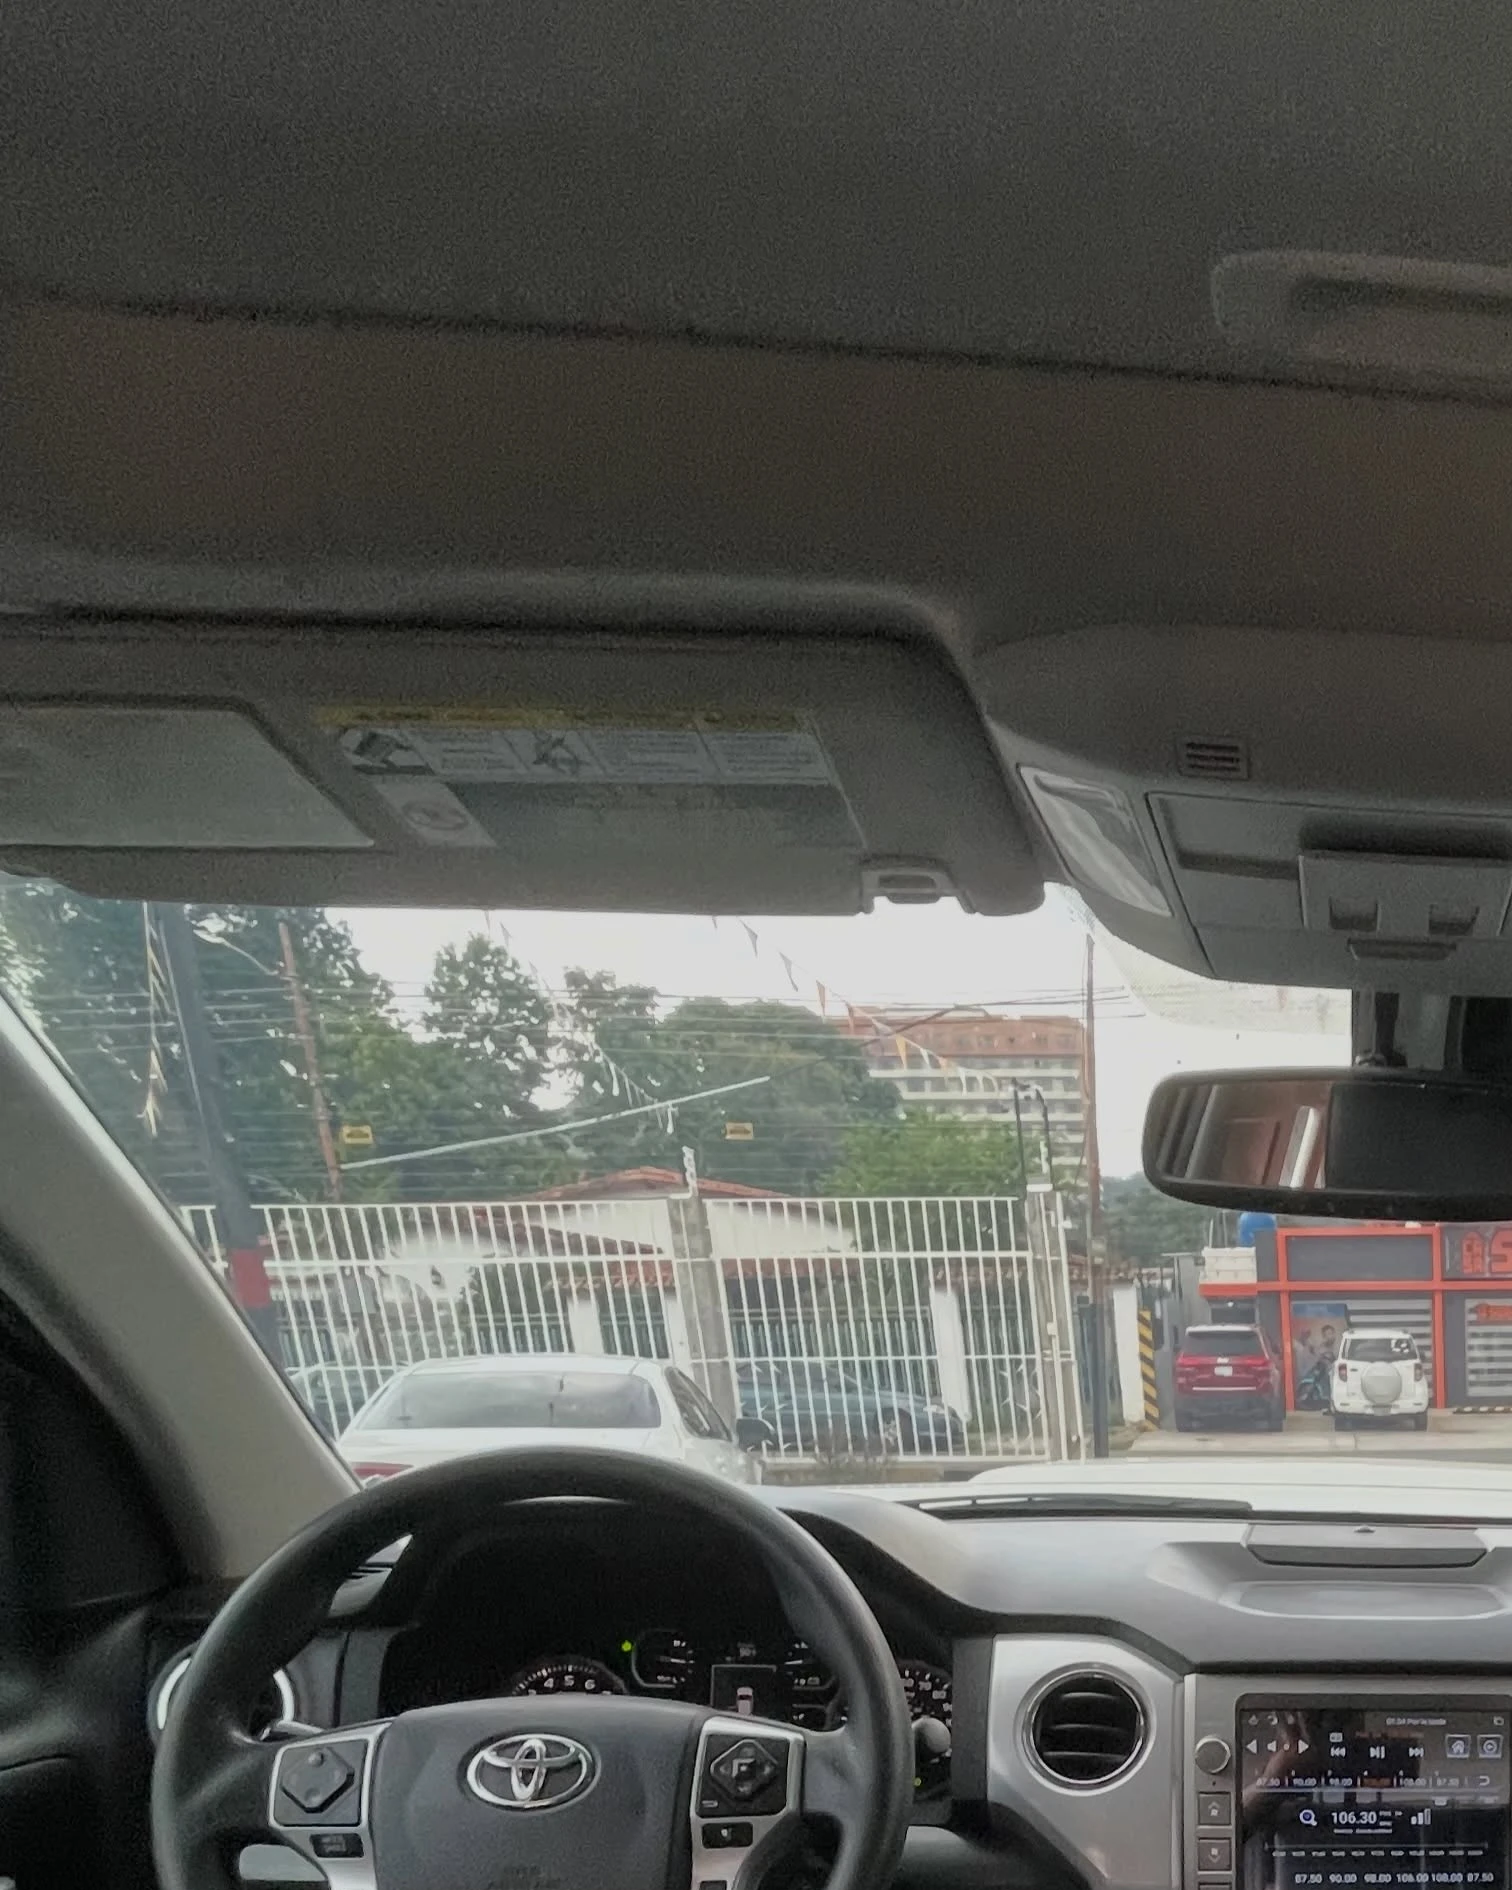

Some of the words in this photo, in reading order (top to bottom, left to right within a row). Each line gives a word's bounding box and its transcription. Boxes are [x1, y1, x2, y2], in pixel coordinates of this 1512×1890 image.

[543, 1678, 554, 1688] 4
[564, 1675, 574, 1686] 5
[584, 1680, 596, 1690] 6
[1331, 1811, 1378, 1825] 106.30
